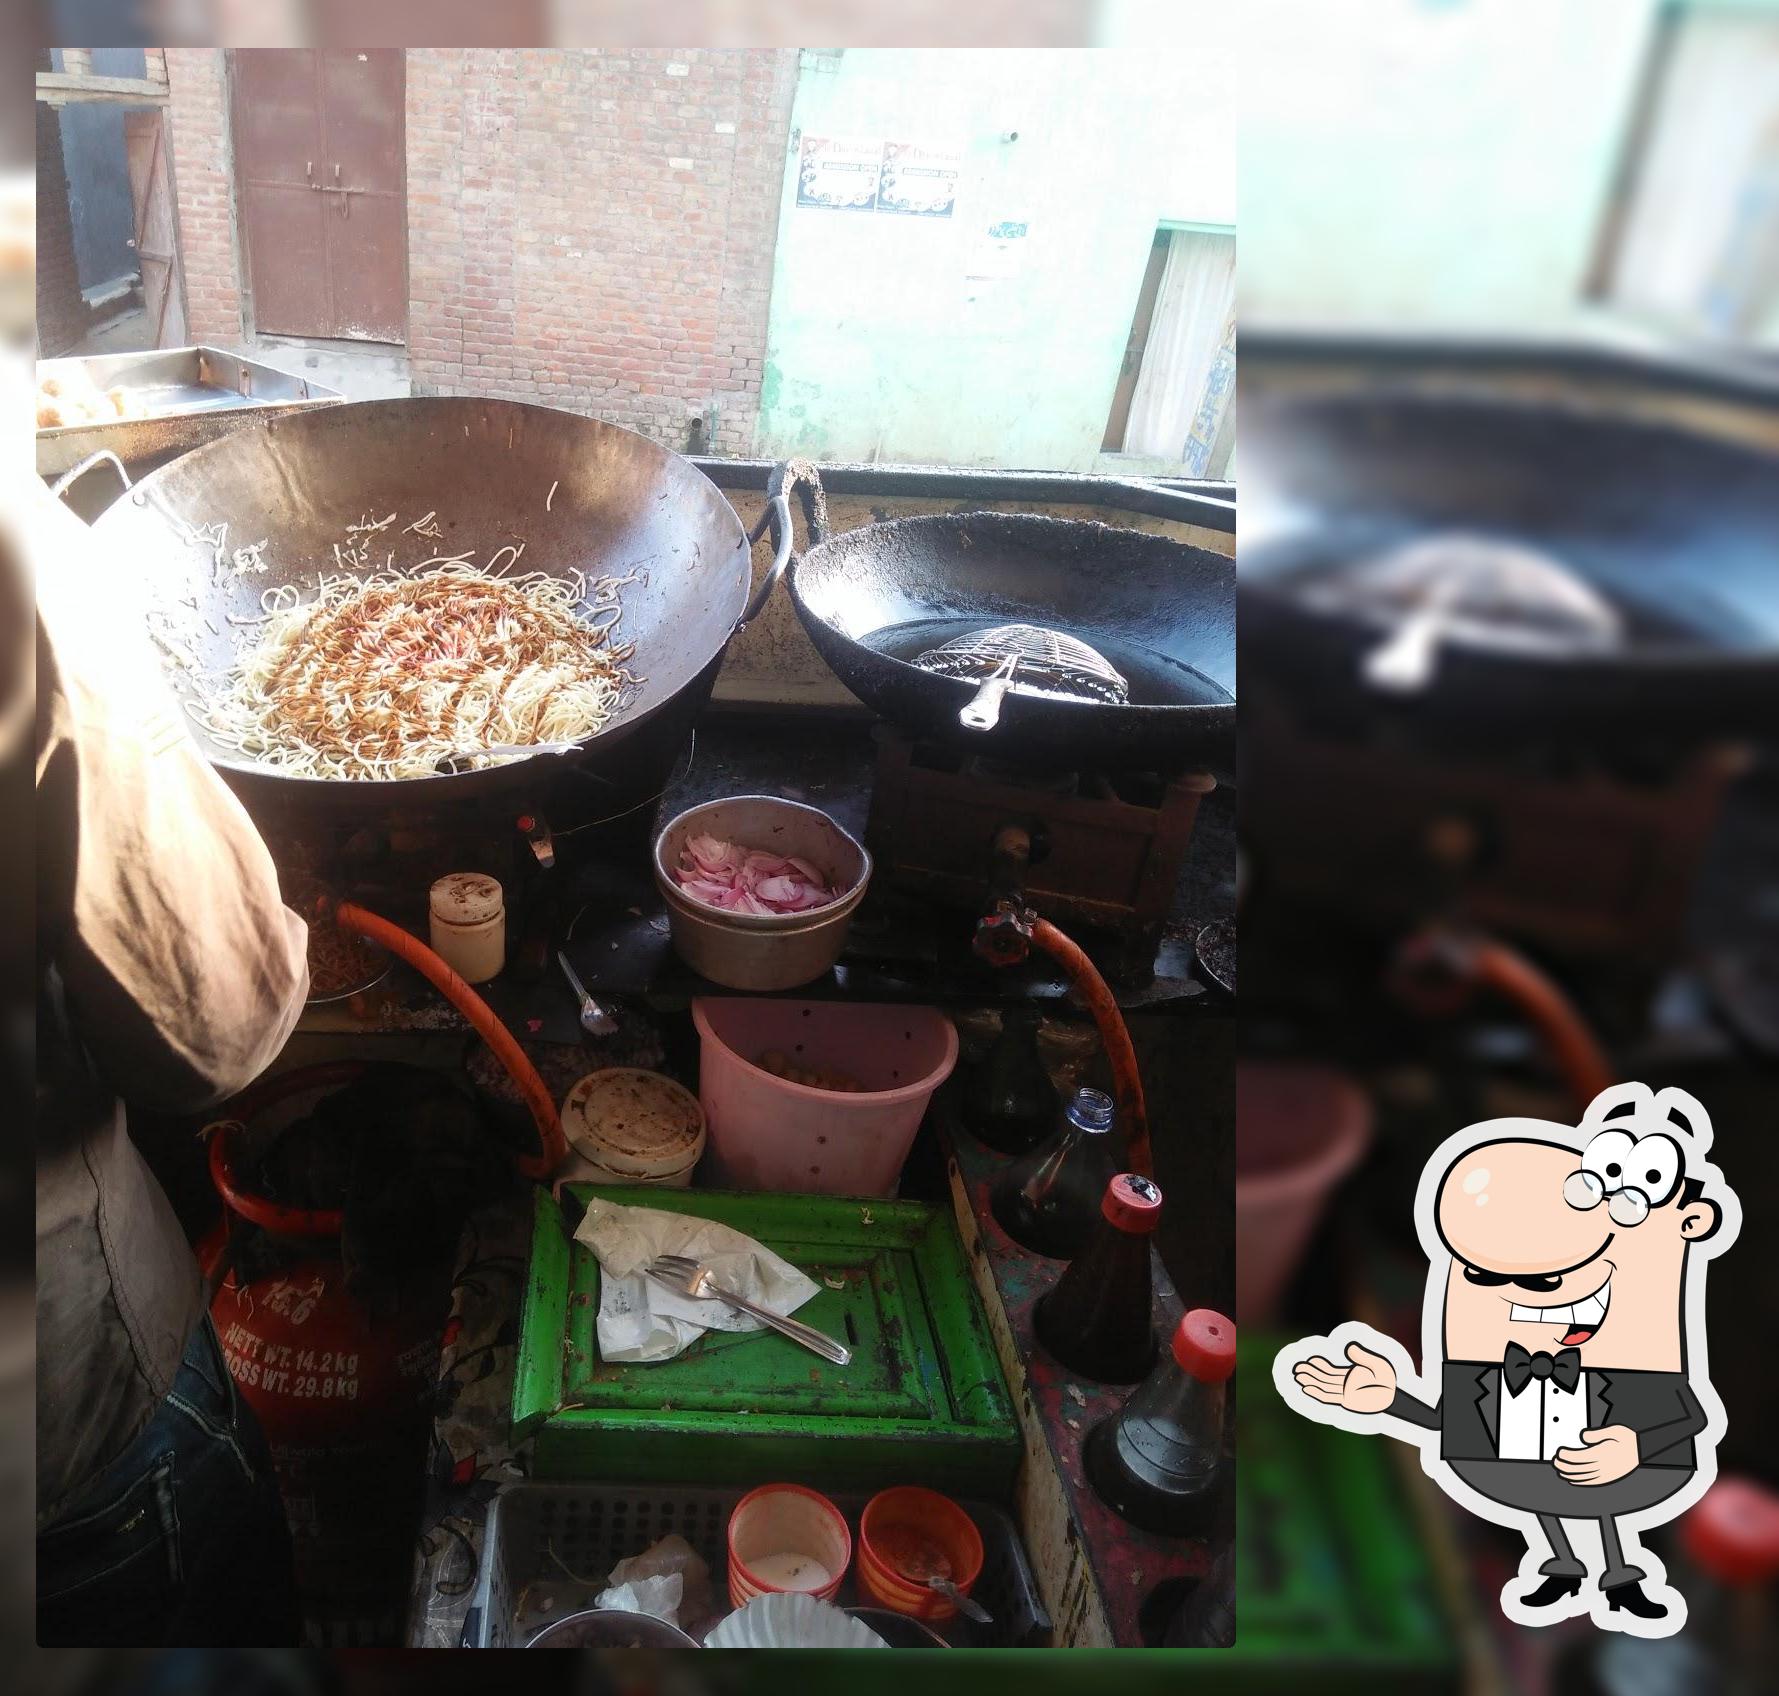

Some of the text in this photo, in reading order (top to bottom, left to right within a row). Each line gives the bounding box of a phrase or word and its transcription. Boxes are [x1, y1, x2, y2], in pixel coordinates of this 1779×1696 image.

[224, 1321, 264, 1358] NETT
[264, 1344, 292, 1368] WT.
[262, 1367, 290, 1393] WT.
